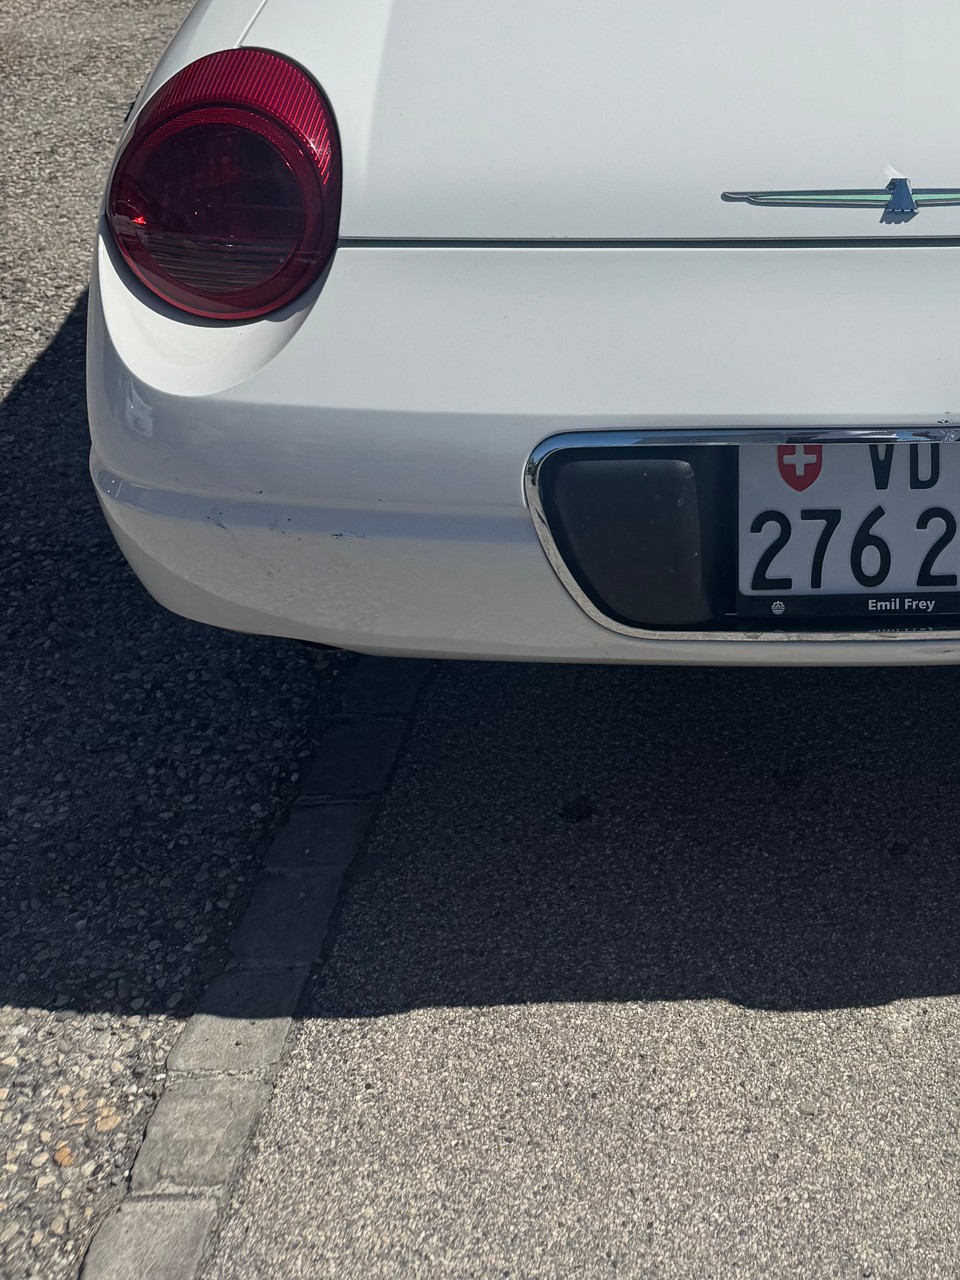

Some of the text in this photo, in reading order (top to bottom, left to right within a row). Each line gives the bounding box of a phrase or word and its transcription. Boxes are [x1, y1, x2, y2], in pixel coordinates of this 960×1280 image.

[869, 443, 940, 490] VD
[750, 505, 892, 591] 276
[868, 598, 936, 612] Emil Frey
